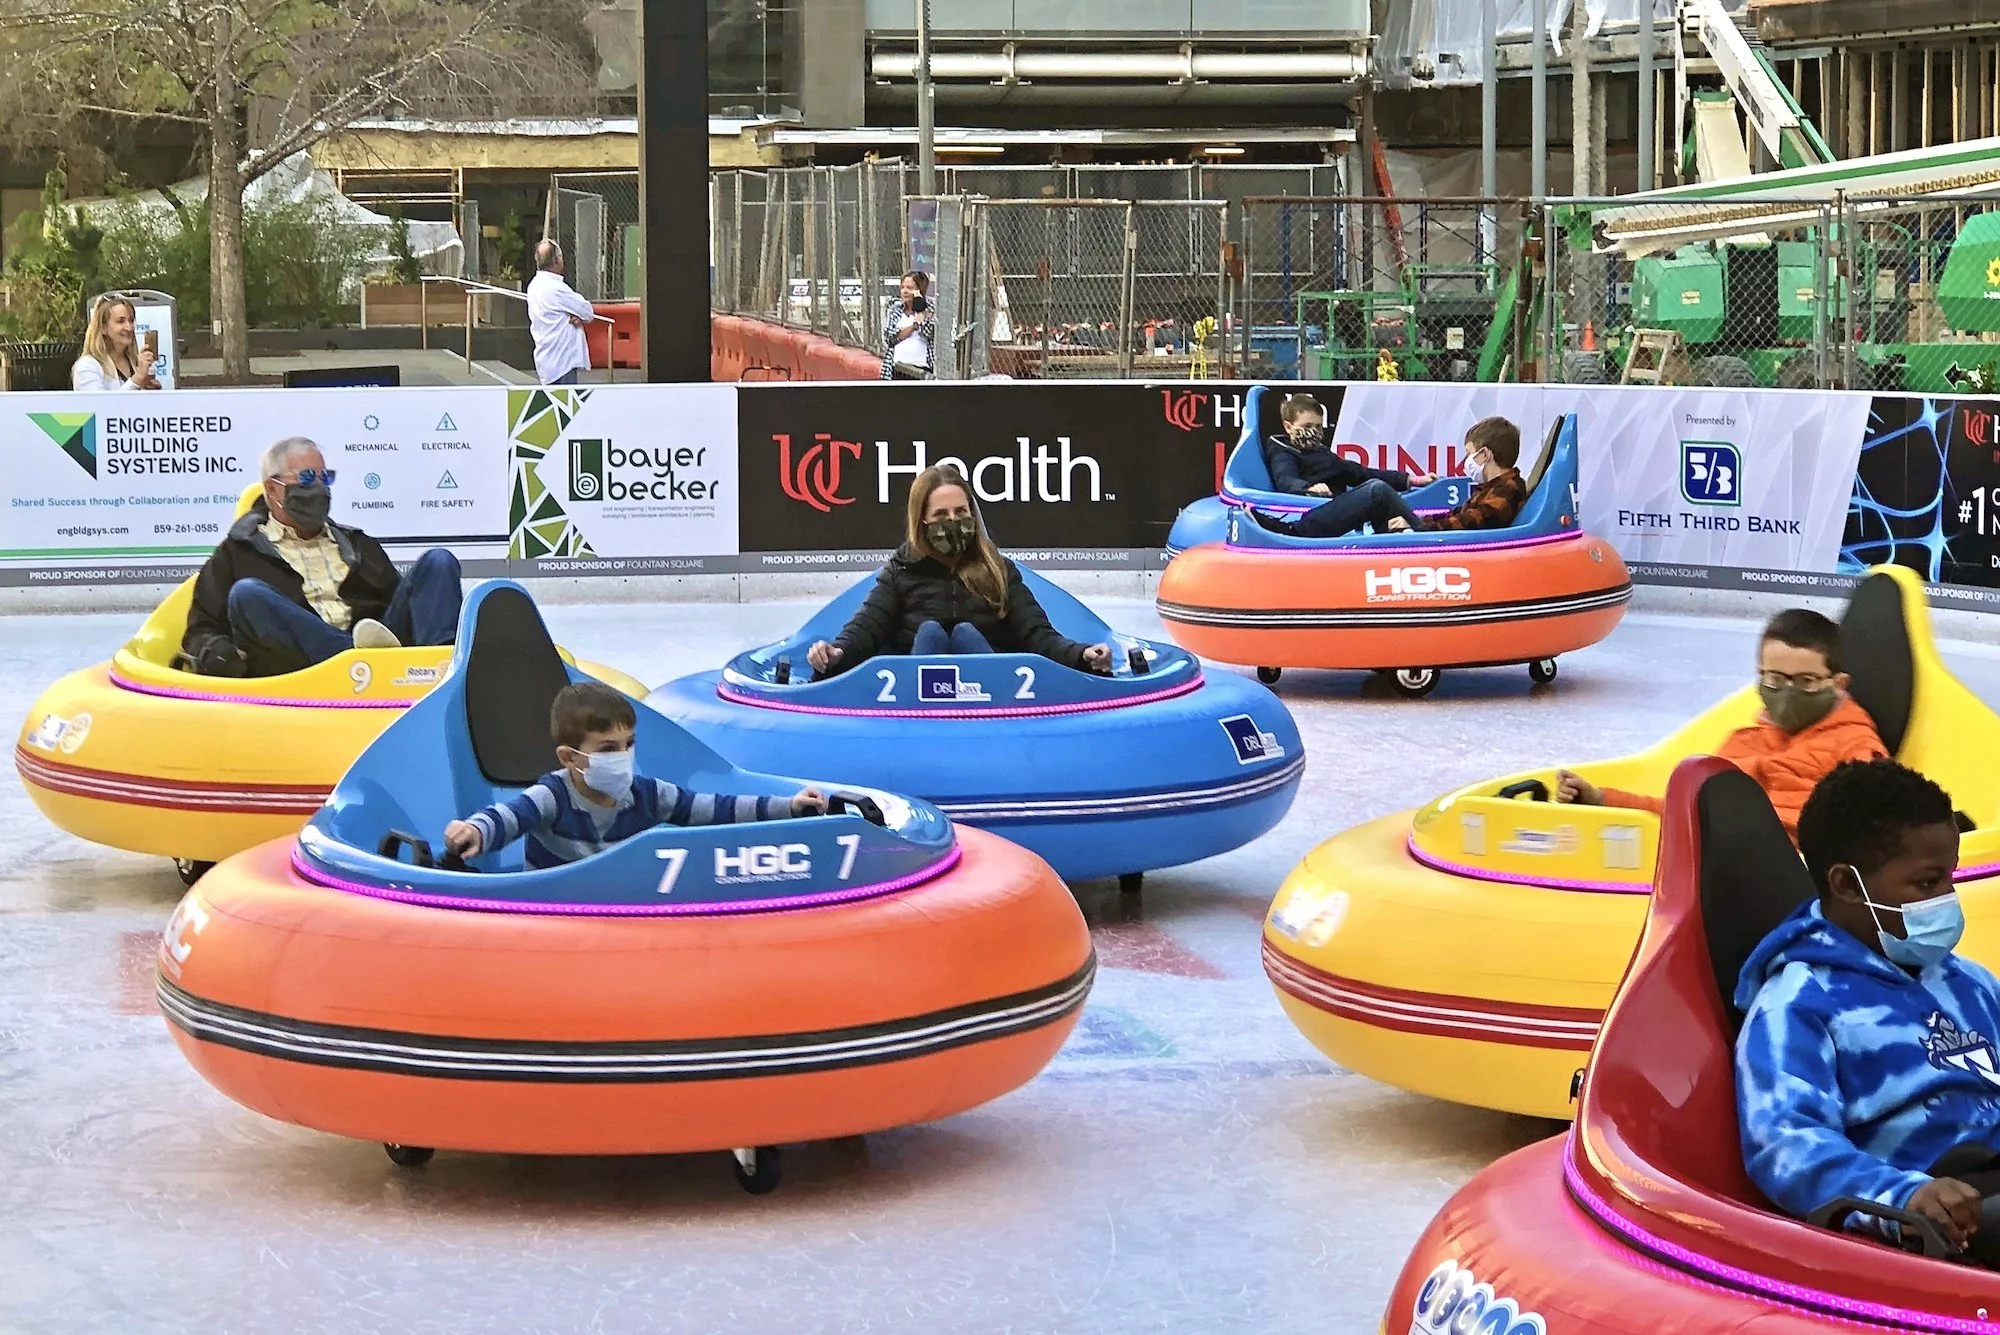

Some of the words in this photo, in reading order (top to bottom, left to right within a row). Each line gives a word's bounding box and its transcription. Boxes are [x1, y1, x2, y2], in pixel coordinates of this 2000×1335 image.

[1161, 389, 1207, 431] UC
[106, 416, 232, 434] ENGINEERED
[1685, 413, 1725, 425] Presented
[1726, 415, 1737, 427] by
[1963, 409, 1991, 446] UC
[106, 437, 199, 454] BUILDING
[344, 443, 399, 451] MECHANICAL
[421, 442, 472, 450] ELECTRICAL
[107, 457, 200, 475] SYSTEMS
[205, 456, 243, 473] INC.
[607, 438, 706, 478] bayer
[772, 433, 863, 512] UC
[608, 470, 719, 500] becker
[11, 497, 45, 507] Shared
[48, 496, 87, 506] Success
[89, 496, 126, 507] through
[128, 495, 190, 505] Collaboration
[193, 495, 210, 504] and
[420, 500, 439, 508] FIRE
[442, 499, 475, 507] SAFETY
[1447, 485, 1459, 505] 3
[351, 501, 395, 509] PLUMBING
[1958, 486, 1986, 535] #1
[56, 525, 130, 536] engbldgsys.com
[153, 523, 219, 534] 859-261-0585
[1618, 509, 1673, 529] FIFTH
[1679, 512, 1741, 532] THIRD
[1748, 516, 1801, 535] BANK
[1231, 520, 1239, 542] 8
[762, 555, 793, 565] PROUD
[794, 554, 836, 563] SPONSOR
[836, 554, 849, 563] OF
[1000, 552, 1038, 561] ONSOR
[1038, 552, 1052, 561] OF
[1052, 551, 1095, 560] FOUNTAIN
[1095, 551, 1130, 560] SQUARE
[538, 561, 569, 571] PROUD
[570, 560, 612, 570] SPONSOR
[613, 560, 626, 569] OF
[626, 559, 669, 569] FOUNTAIN
[670, 559, 703, 569] SQUARE
[1627, 565, 1638, 575] OF
[1638, 566, 1678, 577] FOUNTAIN
[1678, 567, 1709, 579] SQUARE
[29, 571, 62, 580] PROUD
[62, 570, 107, 579] SPONSOR
[107, 570, 120, 578] OF
[120, 569, 166, 578] FOUNTAIN
[1365, 566, 1471, 596] HGC
[1741, 571, 1770, 581] PROUD
[1770, 573, 1808, 584] SPONSOR
[1807, 575, 1819, 585] OF
[1819, 576, 1857, 588] FOUNTAIN
[1366, 594, 1472, 603] CONSTRUCTION
[1941, 588, 1974, 600] SPONSOR
[1974, 591, 1984, 601] OF
[349, 660, 373, 694] 9
[876, 669, 897, 702] 2
[1014, 666, 1036, 699] 2
[656, 848, 689, 894] 7
[714, 843, 811, 877] HGC
[836, 833, 861, 880] 7
